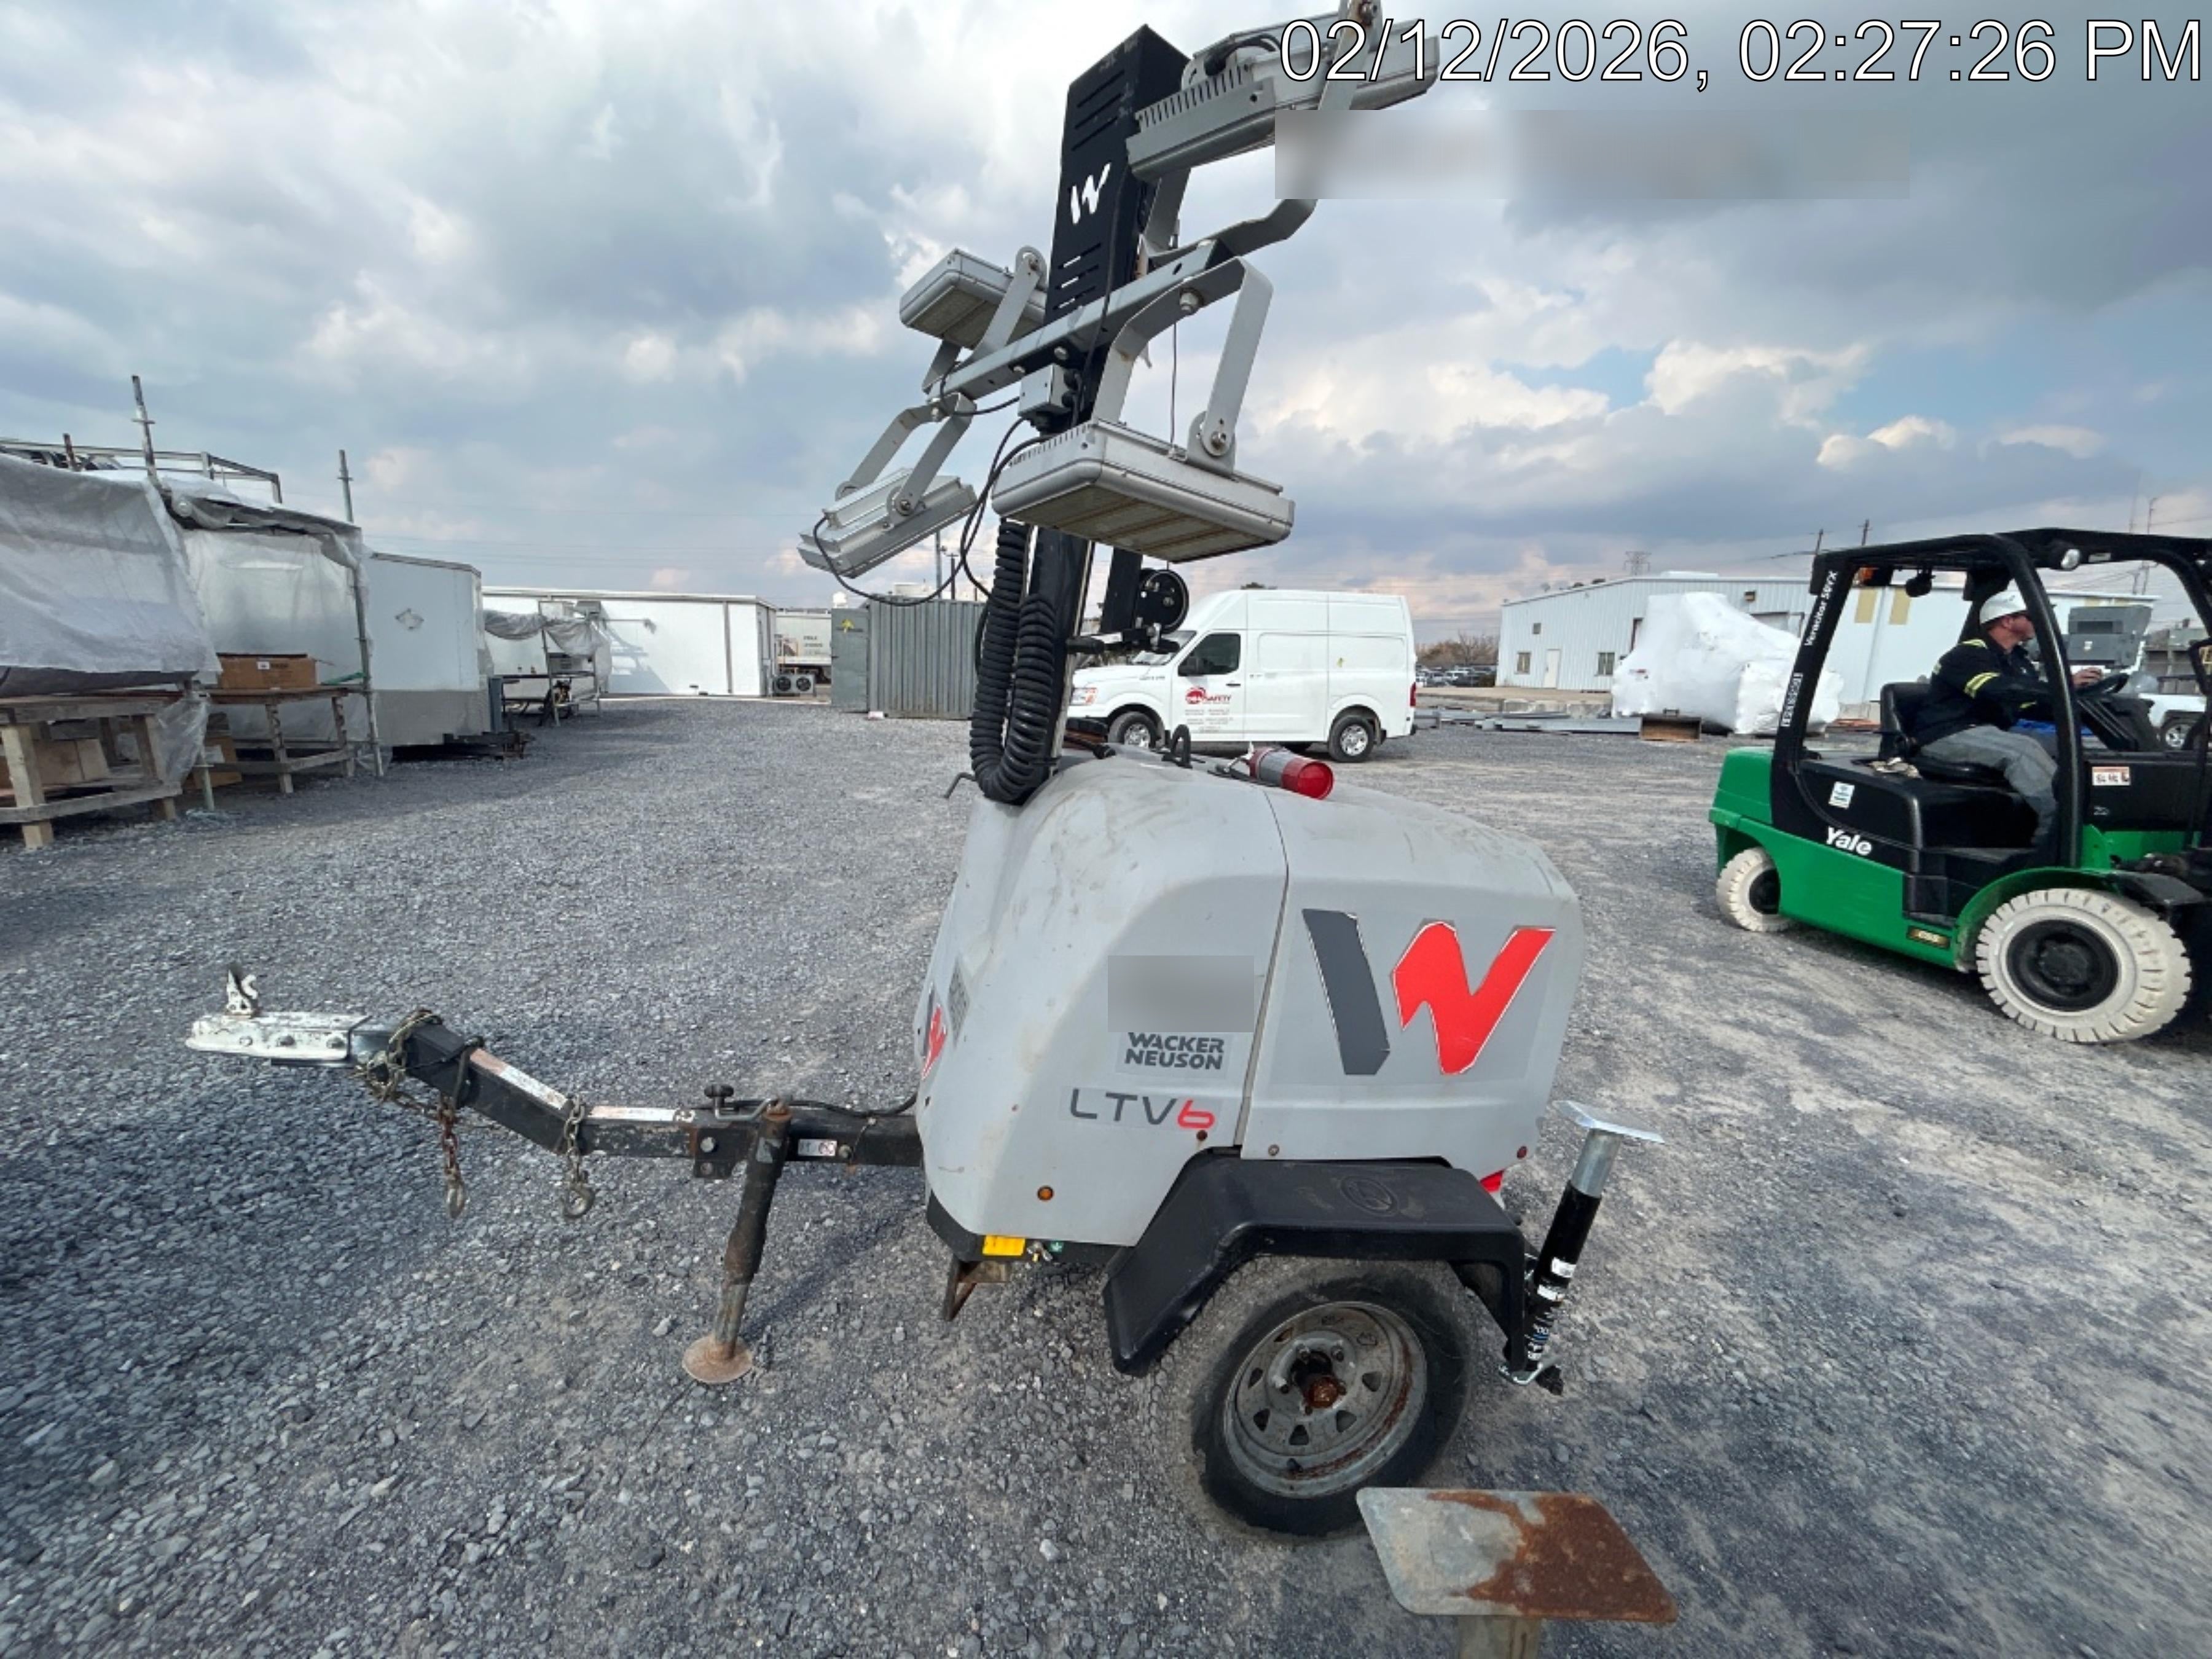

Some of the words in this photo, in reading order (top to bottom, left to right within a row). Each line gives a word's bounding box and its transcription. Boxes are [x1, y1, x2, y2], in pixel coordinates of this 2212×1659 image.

[1826, 825, 1872, 855] Yale
[1128, 1032, 1225, 1053] WACKER
[1124, 1048, 1223, 1070] NEUSON
[1070, 1089, 1215, 1129] LTV6
